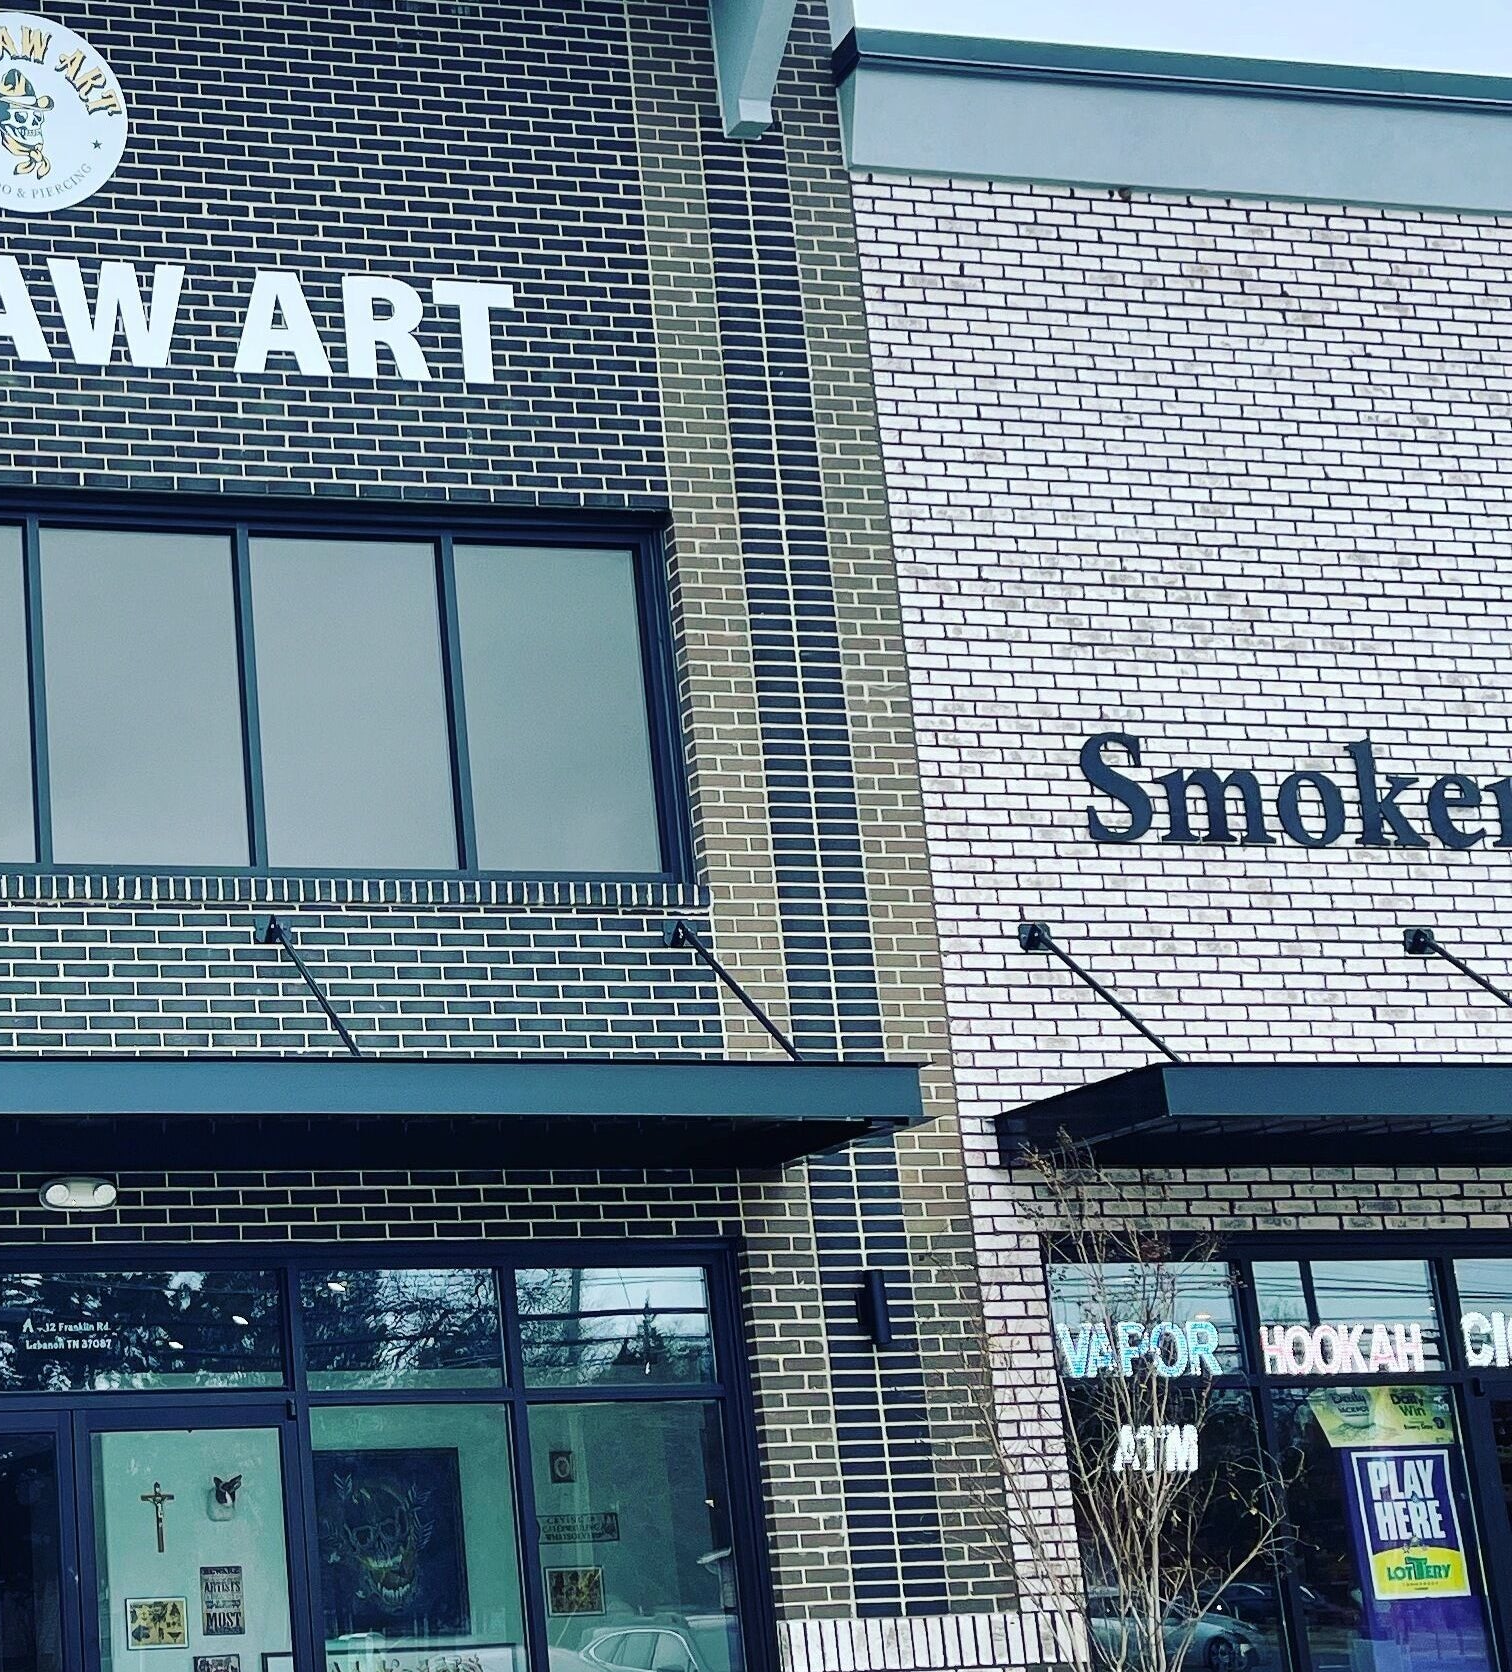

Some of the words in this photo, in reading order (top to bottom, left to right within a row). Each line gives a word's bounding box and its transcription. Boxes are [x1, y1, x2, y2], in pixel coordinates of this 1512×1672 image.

[55, 48, 123, 117] ART
[16, 188, 25, 199] &
[31, 163, 92, 199] PIERCING
[233, 270, 514, 384] ART
[25, 1339, 65, 1350] Lebanon
[66, 1340, 80, 1350] TN
[81, 1339, 112, 1350] 37087
[58, 1322, 95, 1332] Franklin
[1462, 1311, 1512, 1367] CI
[1055, 1321, 1224, 1378] VAPOR
[1259, 1323, 1425, 1374] HOOKAH
[1399, 1404, 1426, 1416] Win
[1113, 1424, 1199, 1471] ATM
[1367, 1459, 1435, 1500] PLAY
[1374, 1500, 1446, 1541] HERE
[204, 1581, 241, 1592] ARTISTS
[1387, 1556, 1451, 1581] LOTTERY
